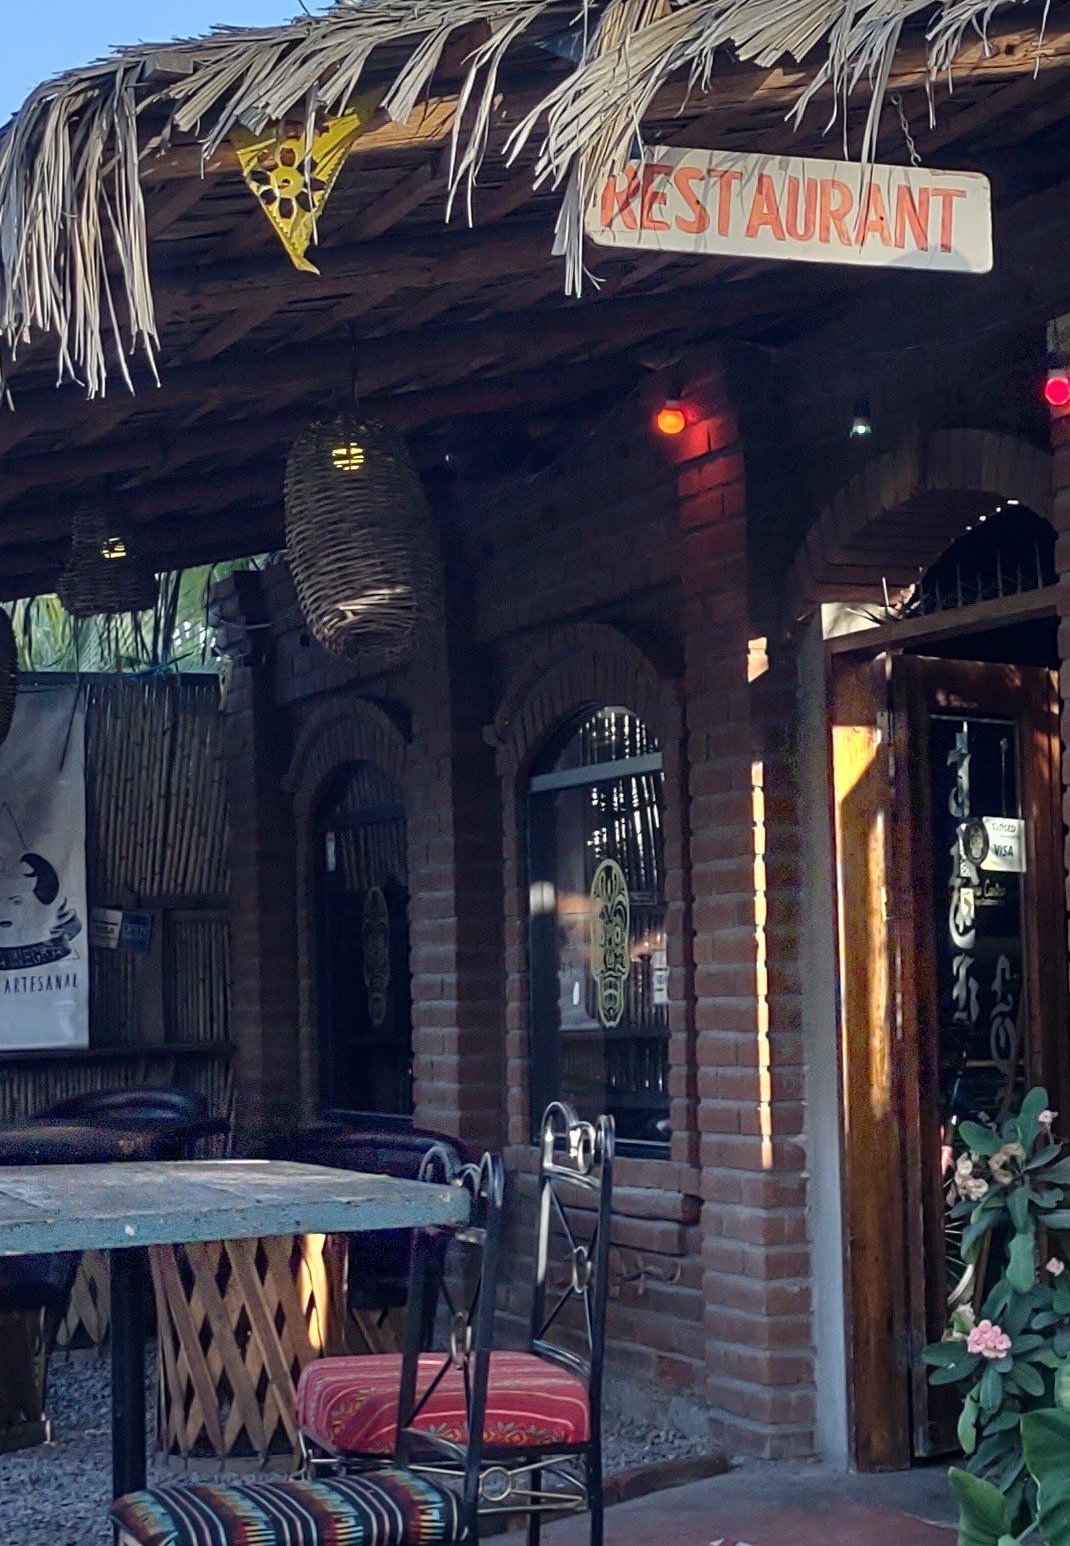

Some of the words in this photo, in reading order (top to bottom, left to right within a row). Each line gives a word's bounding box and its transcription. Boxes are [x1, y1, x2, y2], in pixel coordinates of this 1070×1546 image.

[600, 163, 967, 254] RESTAURANT
[992, 823, 1016, 833] CLOSED
[993, 844, 1014, 858] VISA
[4, 973, 78, 994] ARTESANAL
